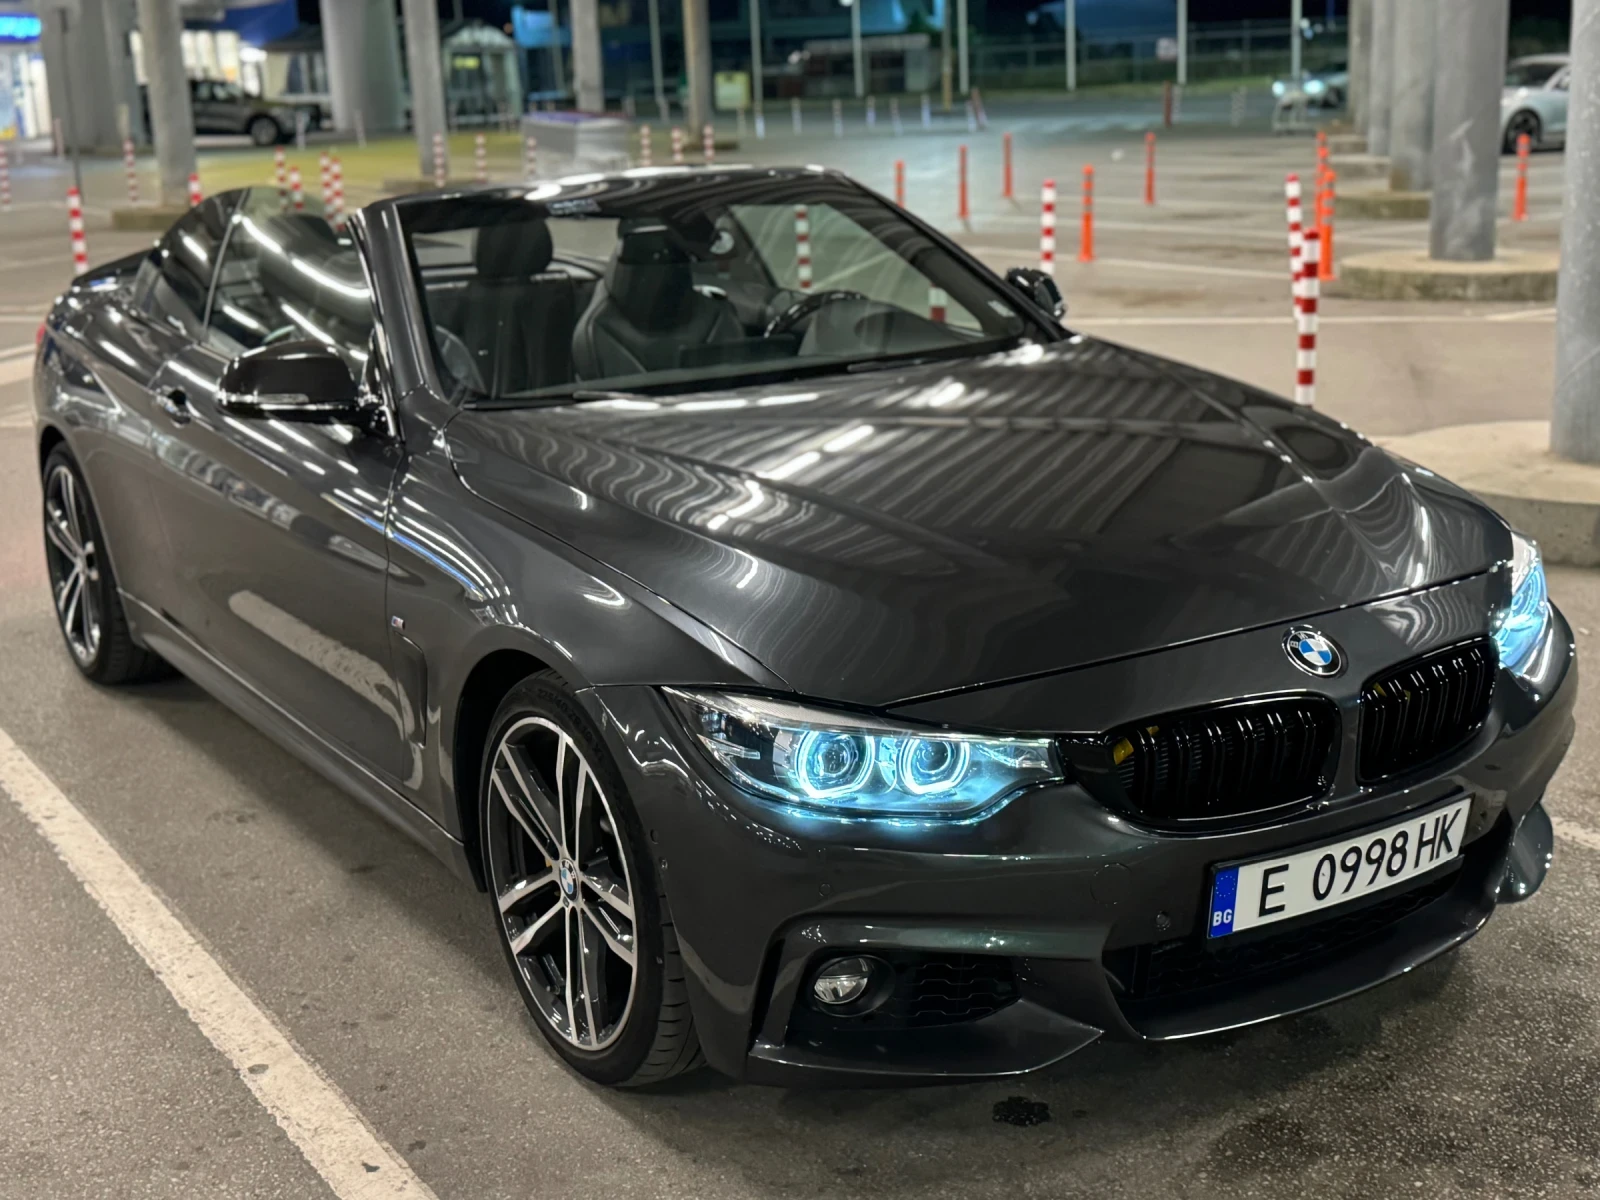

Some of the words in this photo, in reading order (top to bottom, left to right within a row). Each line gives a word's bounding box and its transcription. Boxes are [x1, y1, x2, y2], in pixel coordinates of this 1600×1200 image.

[1258, 864, 1290, 918] E
[1312, 830, 1409, 901] 0998
[1414, 808, 1462, 869] HK
[1213, 909, 1233, 927] BG
